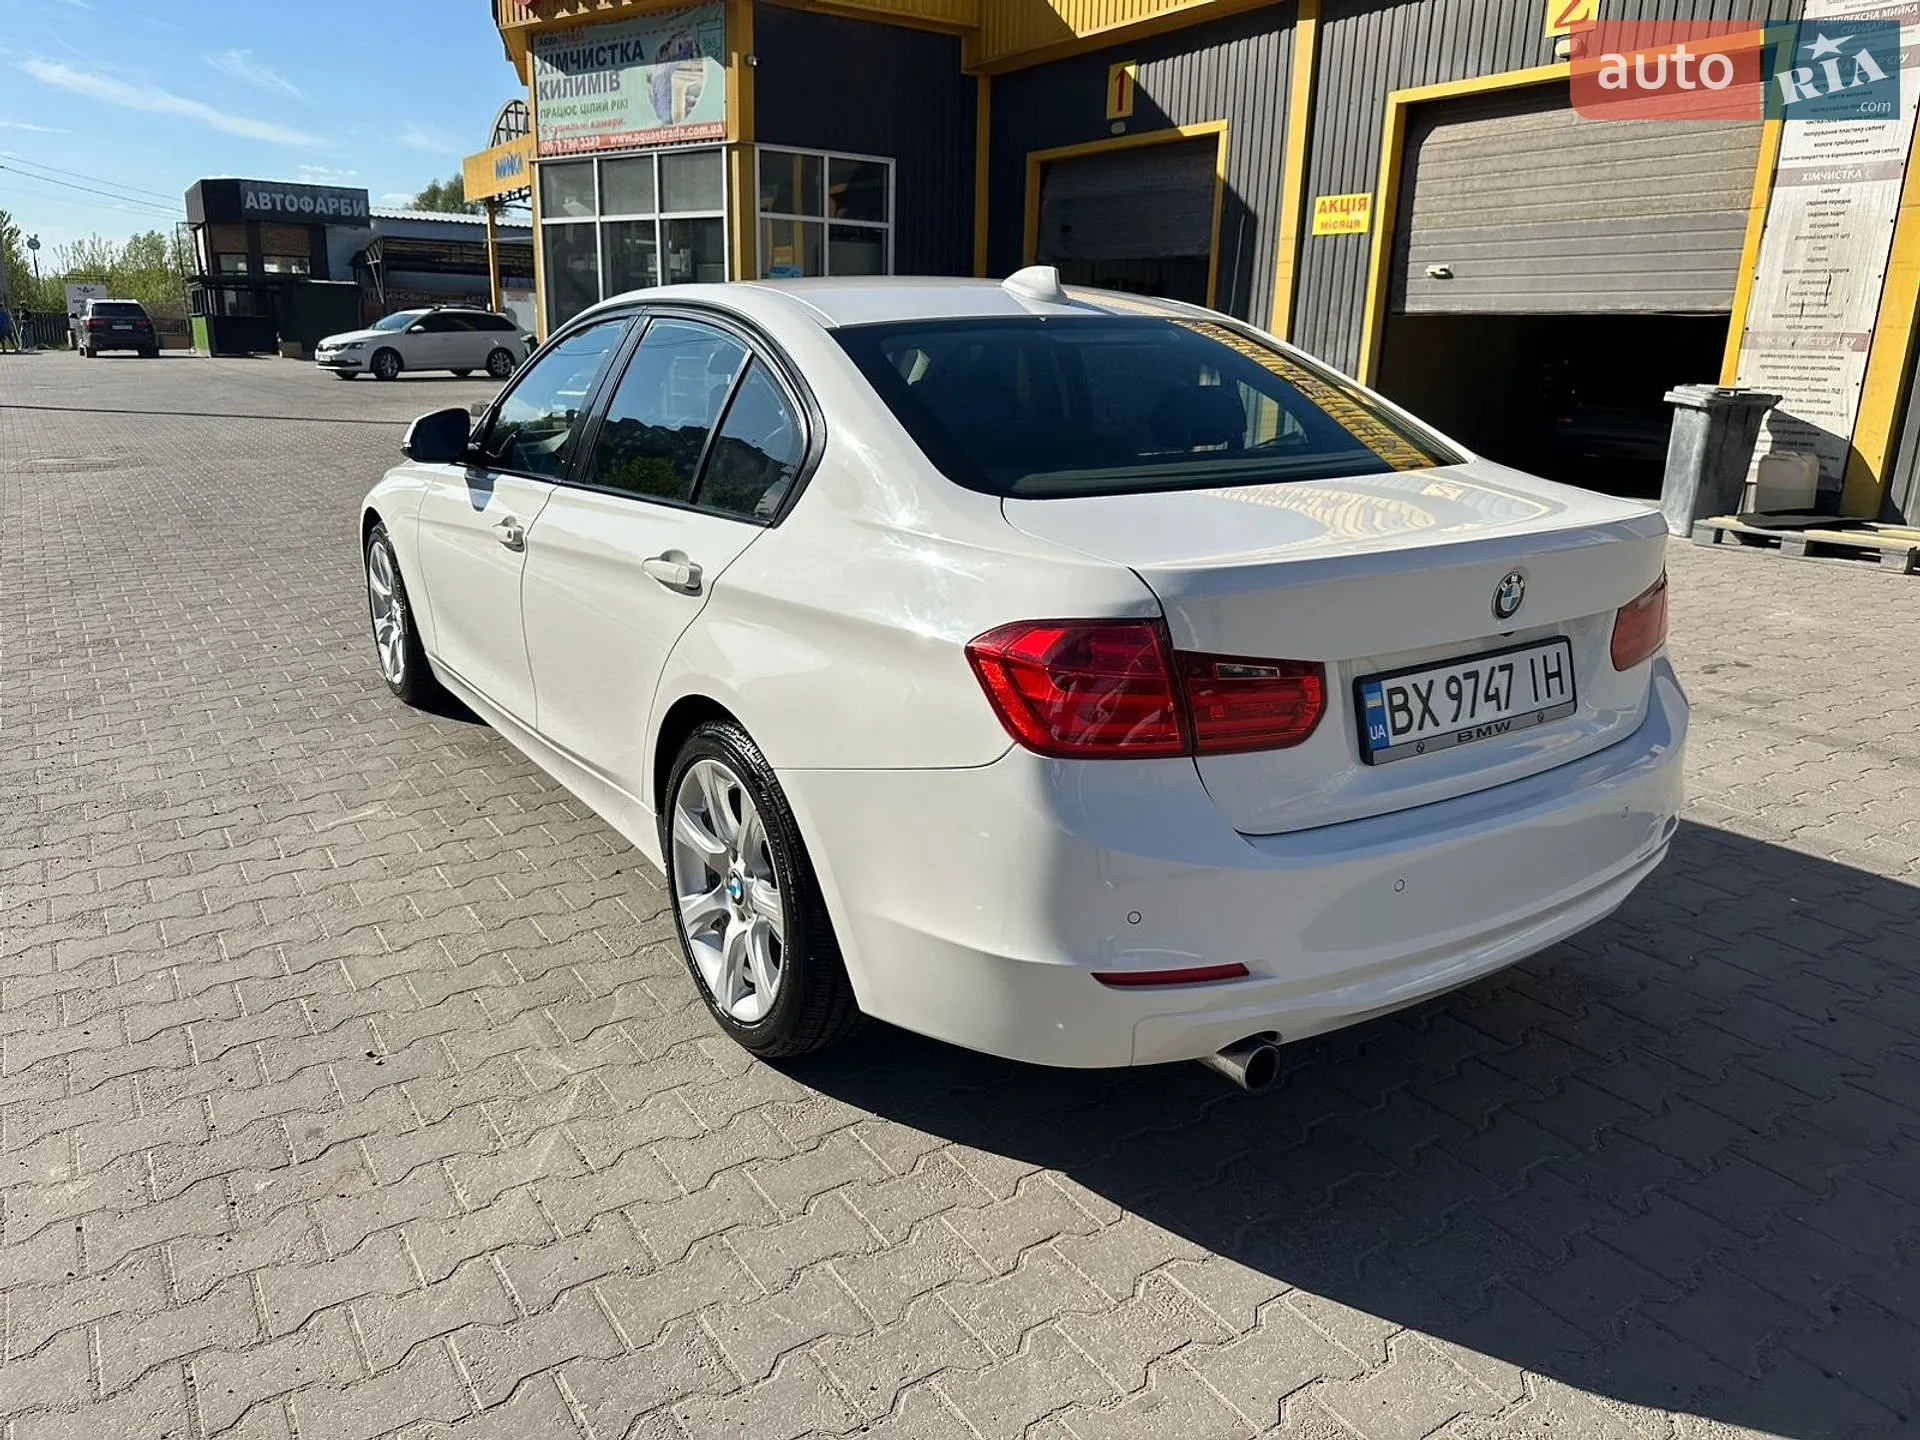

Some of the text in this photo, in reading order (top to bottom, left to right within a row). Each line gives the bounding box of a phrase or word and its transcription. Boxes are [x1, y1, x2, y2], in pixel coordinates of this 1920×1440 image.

[538, 40, 645, 75] ХІМЧИСТКА
[539, 70, 621, 101] КИЛИМІВ
[540, 104, 578, 119] ПРАЦЮЄ
[1801, 169, 1862, 182] ХІМЧИСТКА
[245, 191, 365, 217] АВТОФАРБИ
[1318, 197, 1368, 215] АКЦІЯ
[1387, 652, 1564, 736] BX 9747 IH
[1370, 724, 1387, 740] UA
[1456, 721, 1512, 743] BMW
